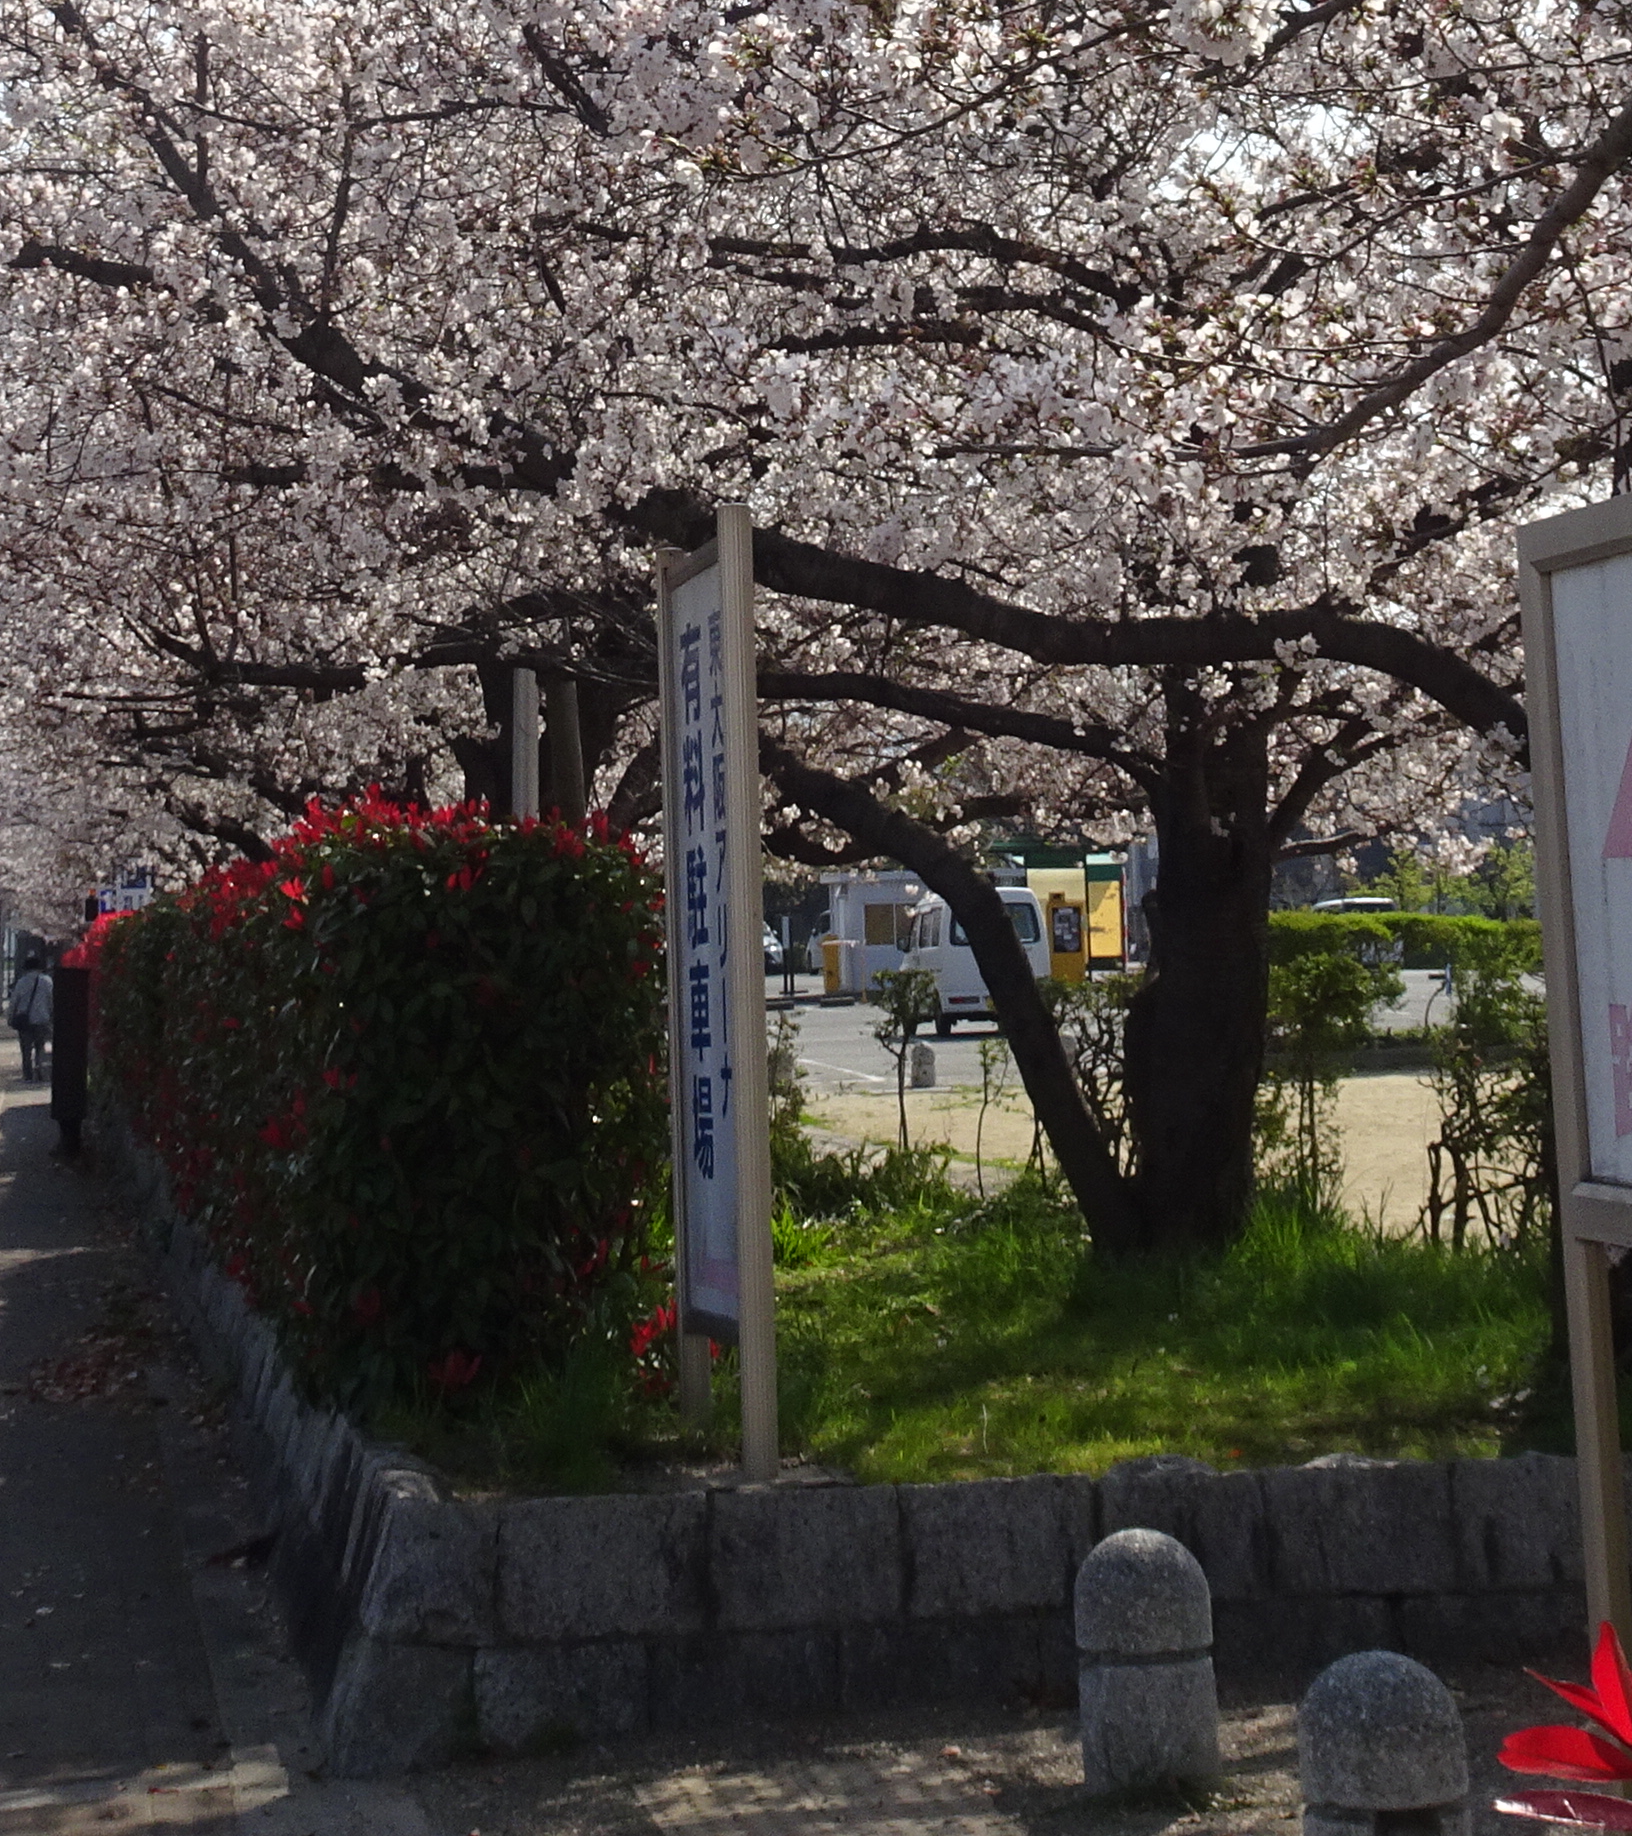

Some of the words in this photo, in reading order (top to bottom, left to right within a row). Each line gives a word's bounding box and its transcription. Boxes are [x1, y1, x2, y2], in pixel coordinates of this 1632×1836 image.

[680, 622, 714, 1180] 有料駐車場
[707, 610, 732, 1119] 東大阪アリーナ
